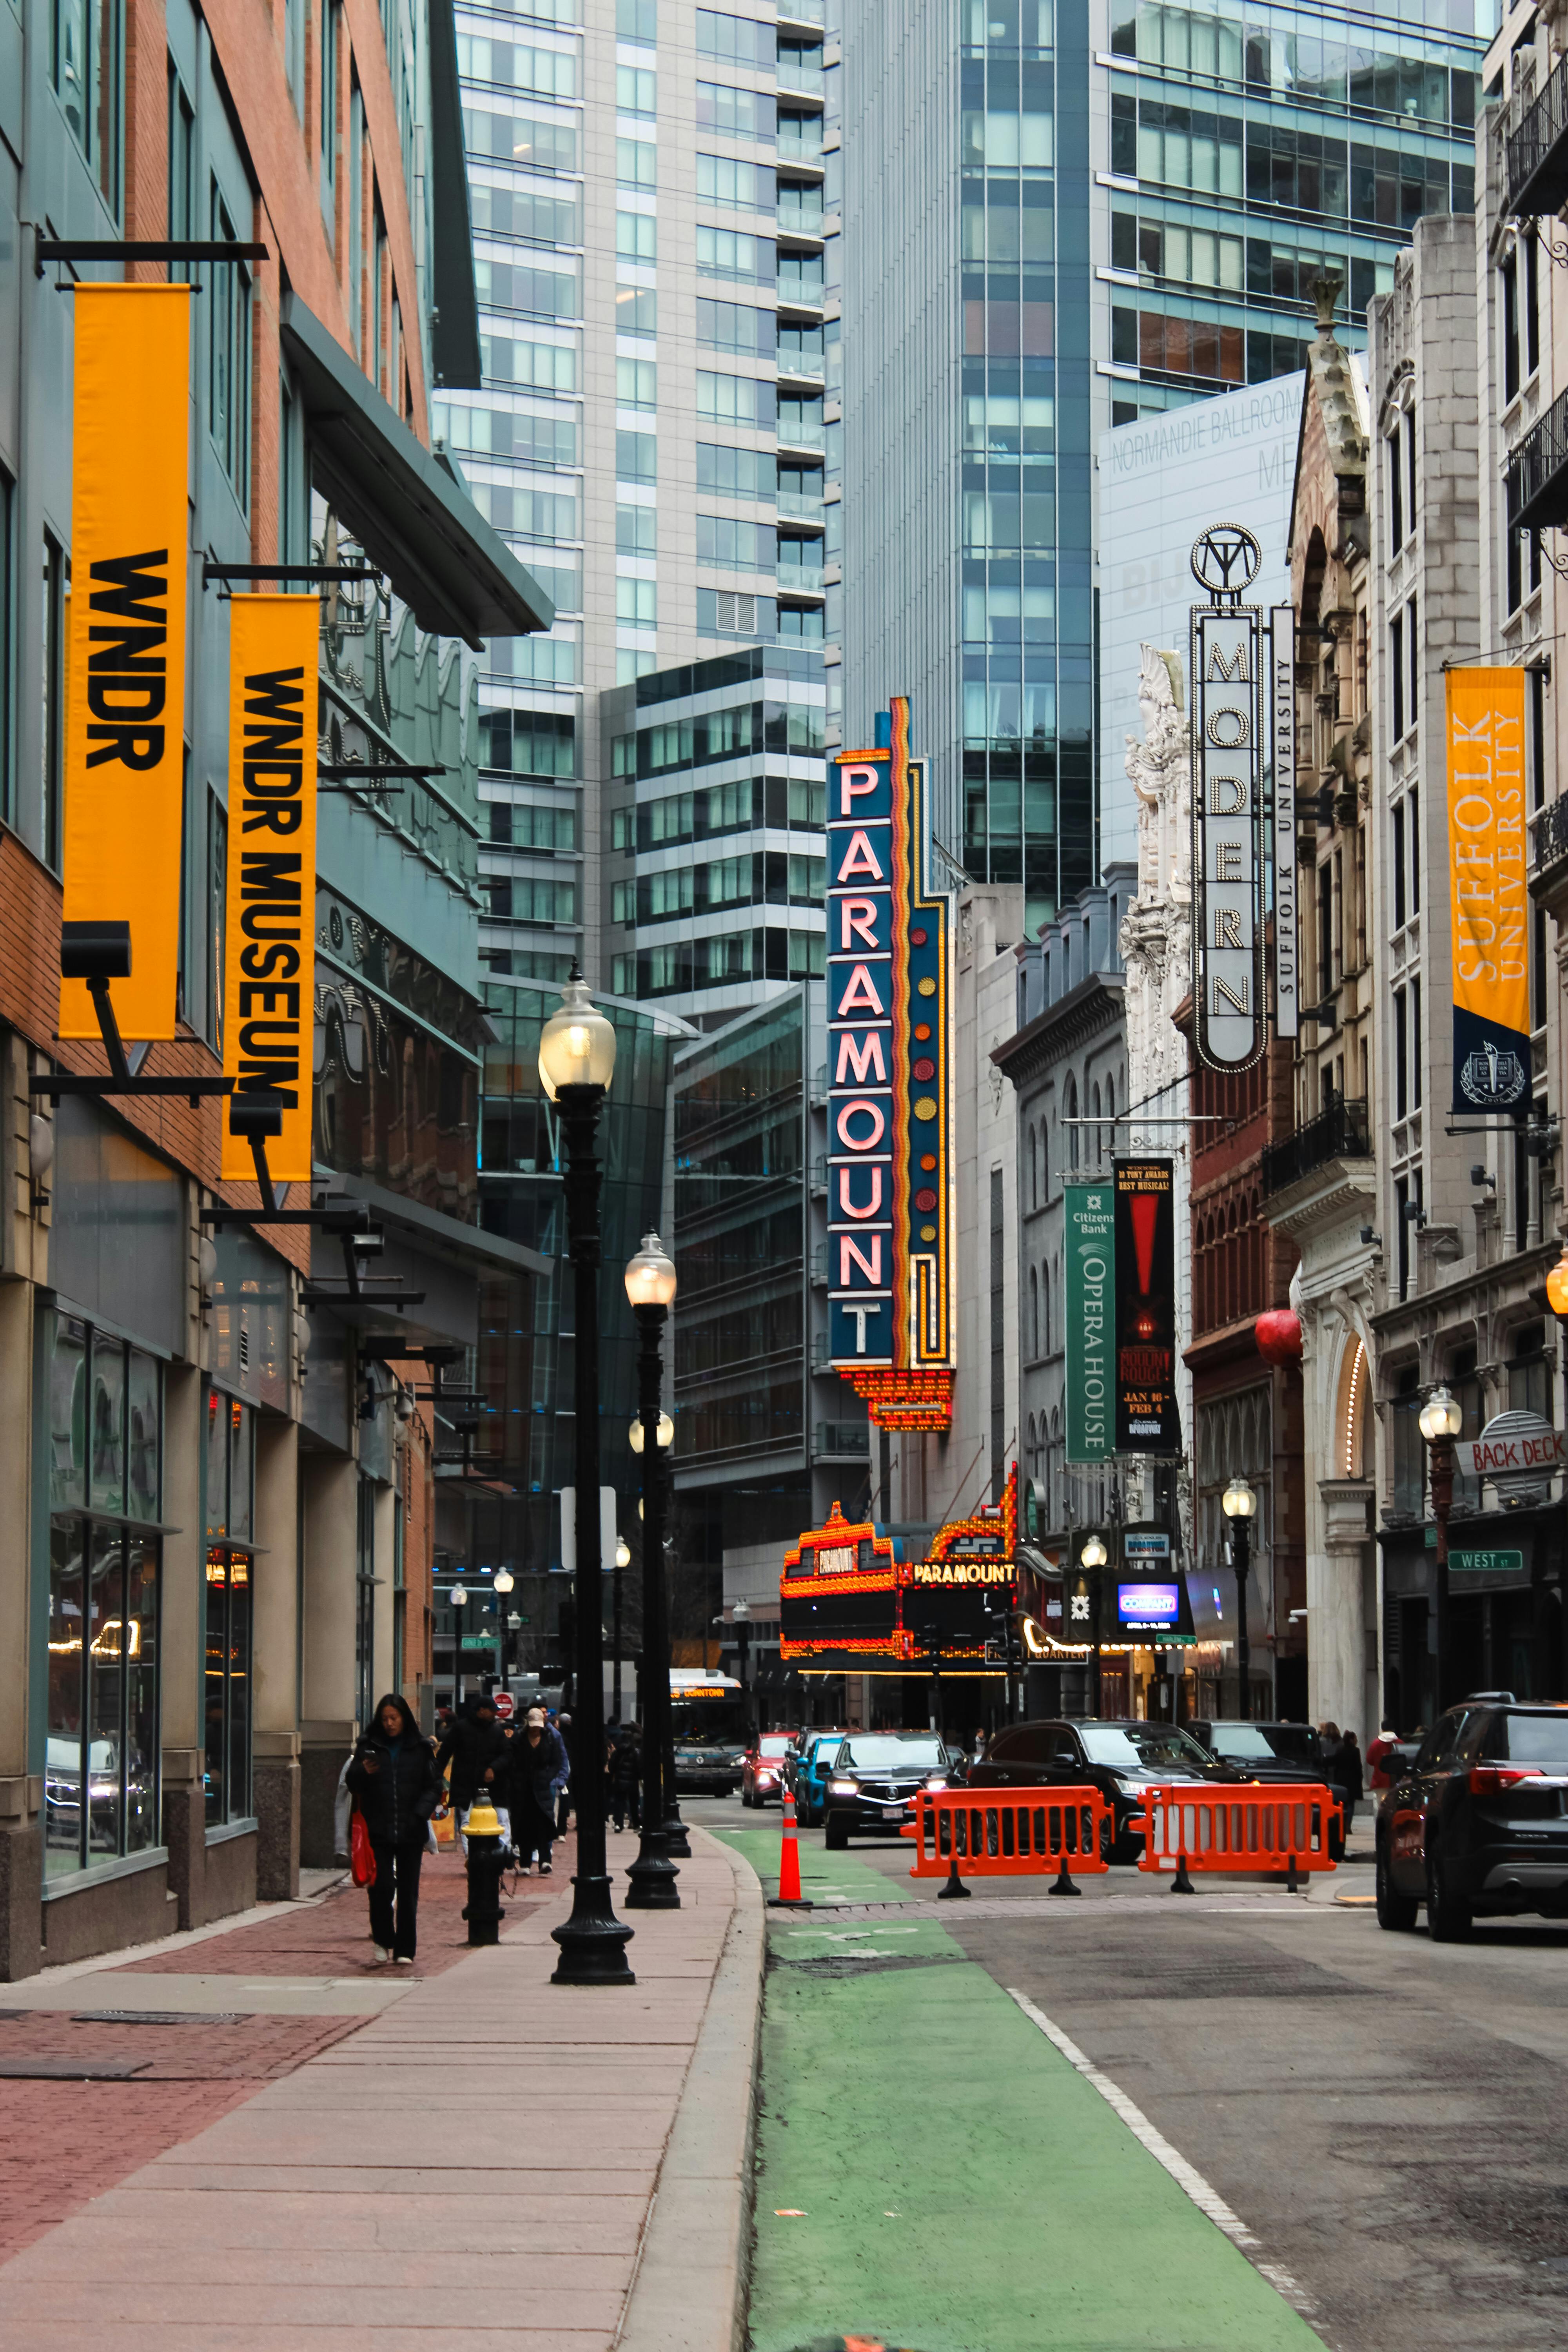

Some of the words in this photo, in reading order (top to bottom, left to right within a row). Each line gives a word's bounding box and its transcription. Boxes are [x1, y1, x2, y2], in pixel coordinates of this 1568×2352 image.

[1113, 415, 1205, 473] NORMANDIE
[1211, 386, 1301, 444] BALLROOM
[86, 548, 168, 771] WNDR
[242, 666, 304, 835] WNDR
[1278, 660, 1291, 832] UNIVERSITY
[1207, 643, 1250, 1015] MODERN
[1453, 710, 1497, 982] SUFFOLK
[1495, 710, 1524, 982] UNIVERSITY
[1279, 865, 1293, 994] SUFFOLK
[238, 852, 301, 1109] MUSEUM
[836, 764, 886, 1353] PARAMOUNT
[1073, 1213, 1114, 1223] Citizens
[1081, 1224, 1107, 1234] Bank
[1119, 1182, 1135, 1190] BEST
[1137, 1181, 1169, 1190] MUSICAL!
[1083, 1258, 1107, 1351] OPERA
[1084, 1356, 1105, 1448] HOUSE
[1123, 1392, 1147, 1402] JAN
[1151, 1393, 1163, 1402] 16
[1129, 1404, 1152, 1414] FEB
[1156, 1404, 1162, 1414] 4
[1472, 1442, 1519, 1472] BACK
[1522, 1434, 1567, 1466] DECK
[915, 1564, 1014, 1583] PARAMOUNT
[1462, 1554, 1495, 1567] WEST
